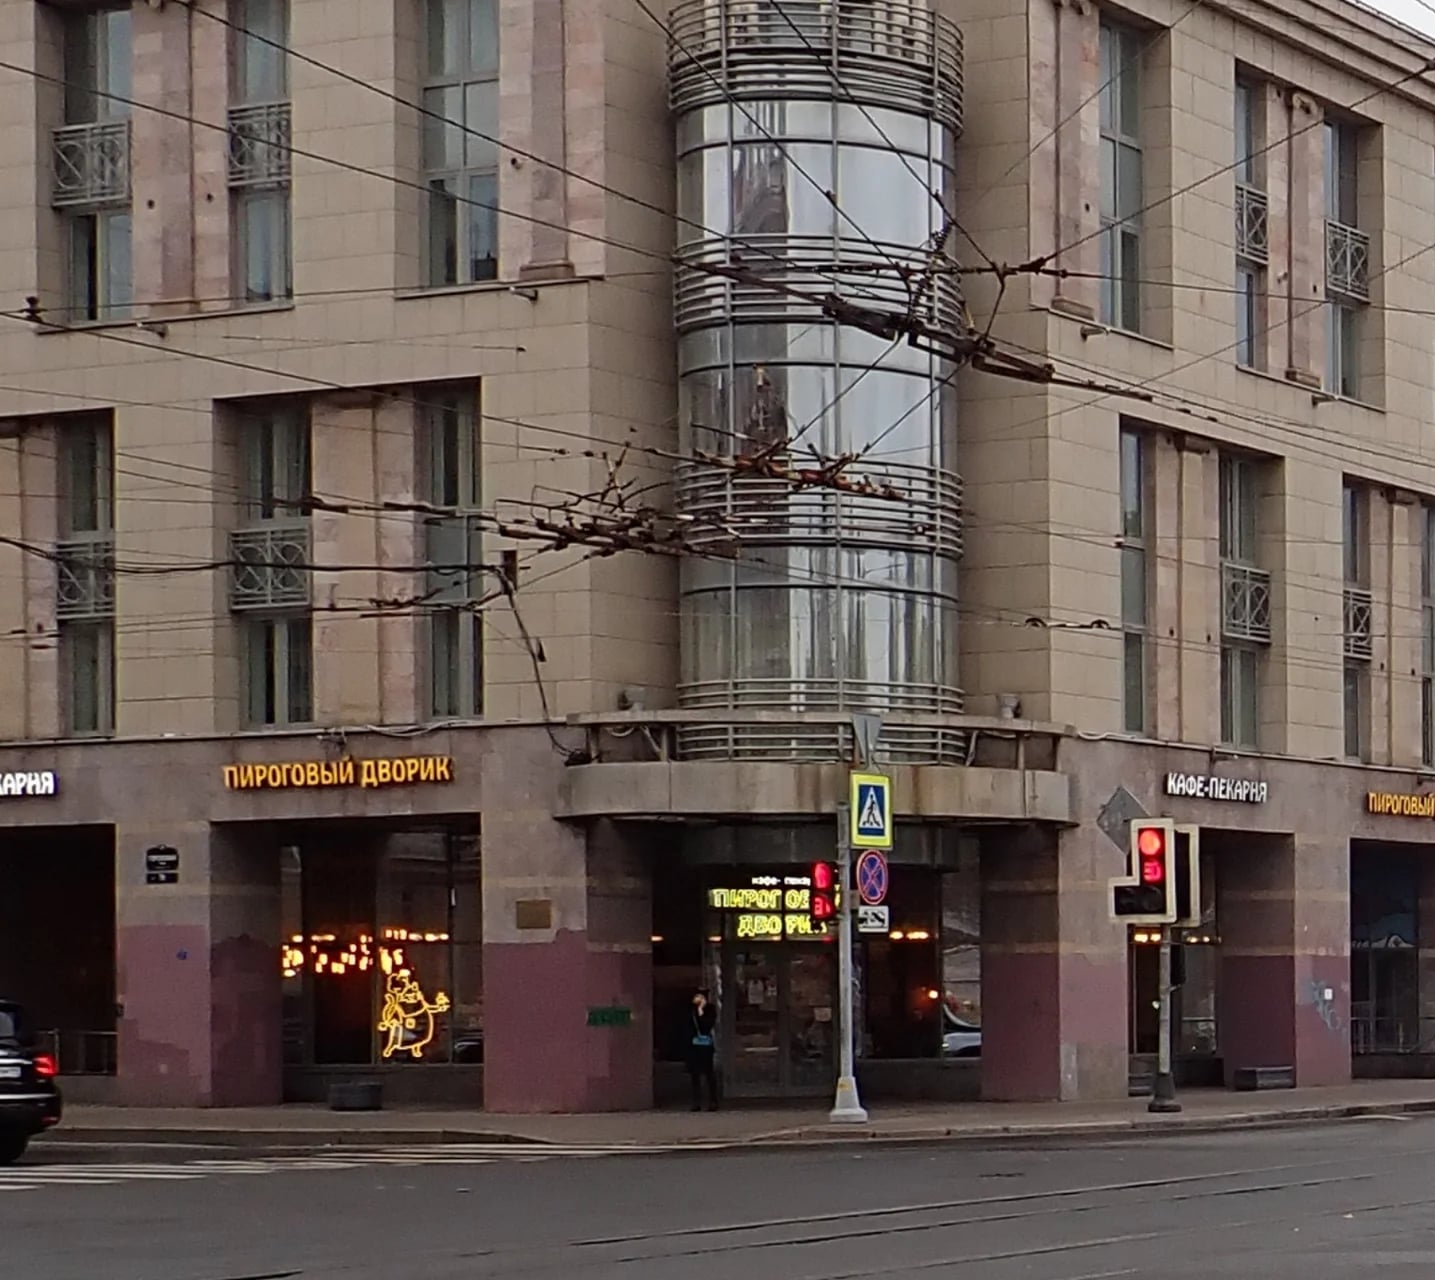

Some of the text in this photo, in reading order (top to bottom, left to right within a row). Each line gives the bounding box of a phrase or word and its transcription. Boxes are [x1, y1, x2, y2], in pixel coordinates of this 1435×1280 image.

[0, 771, 55, 796] АРНЯ
[223, 756, 450, 789] ПИРОГОВЫЙ ДВОРИК
[1167, 772, 1267, 803] КАФЕ-ПЕКАРНЯ
[1367, 791, 1435, 817] ПИРОГОВЫЙ
